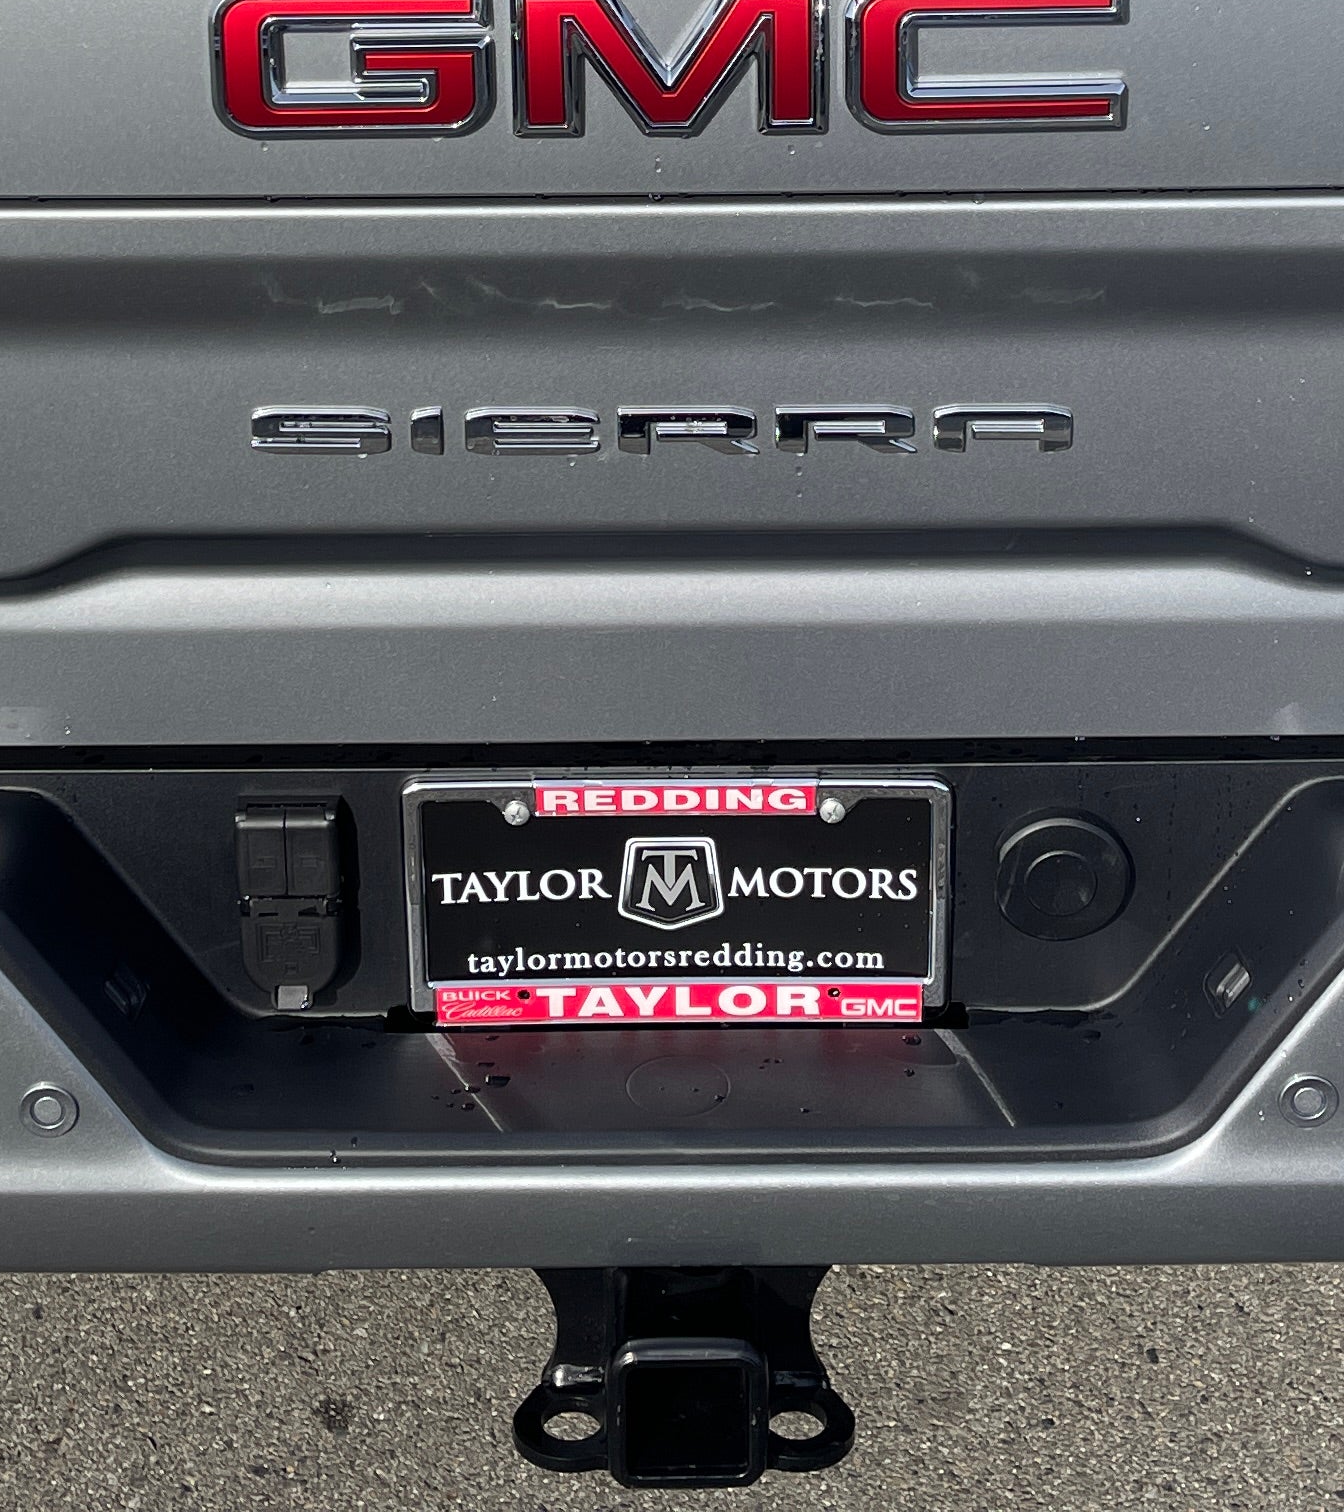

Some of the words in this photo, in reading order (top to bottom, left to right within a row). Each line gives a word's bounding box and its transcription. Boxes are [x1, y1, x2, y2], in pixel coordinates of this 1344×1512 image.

[250, 402, 1074, 456] SIERRA
[542, 787, 807, 812] REDDING
[431, 868, 613, 905] TAYLOR
[727, 866, 918, 901] MOTORS
[467, 942, 885, 977] taylormotorsredding.com
[441, 990, 511, 1003] BUICK
[441, 1000, 524, 1020] Cadillac
[535, 985, 821, 1018] TAYLOR
[840, 998, 918, 1017] GMC
